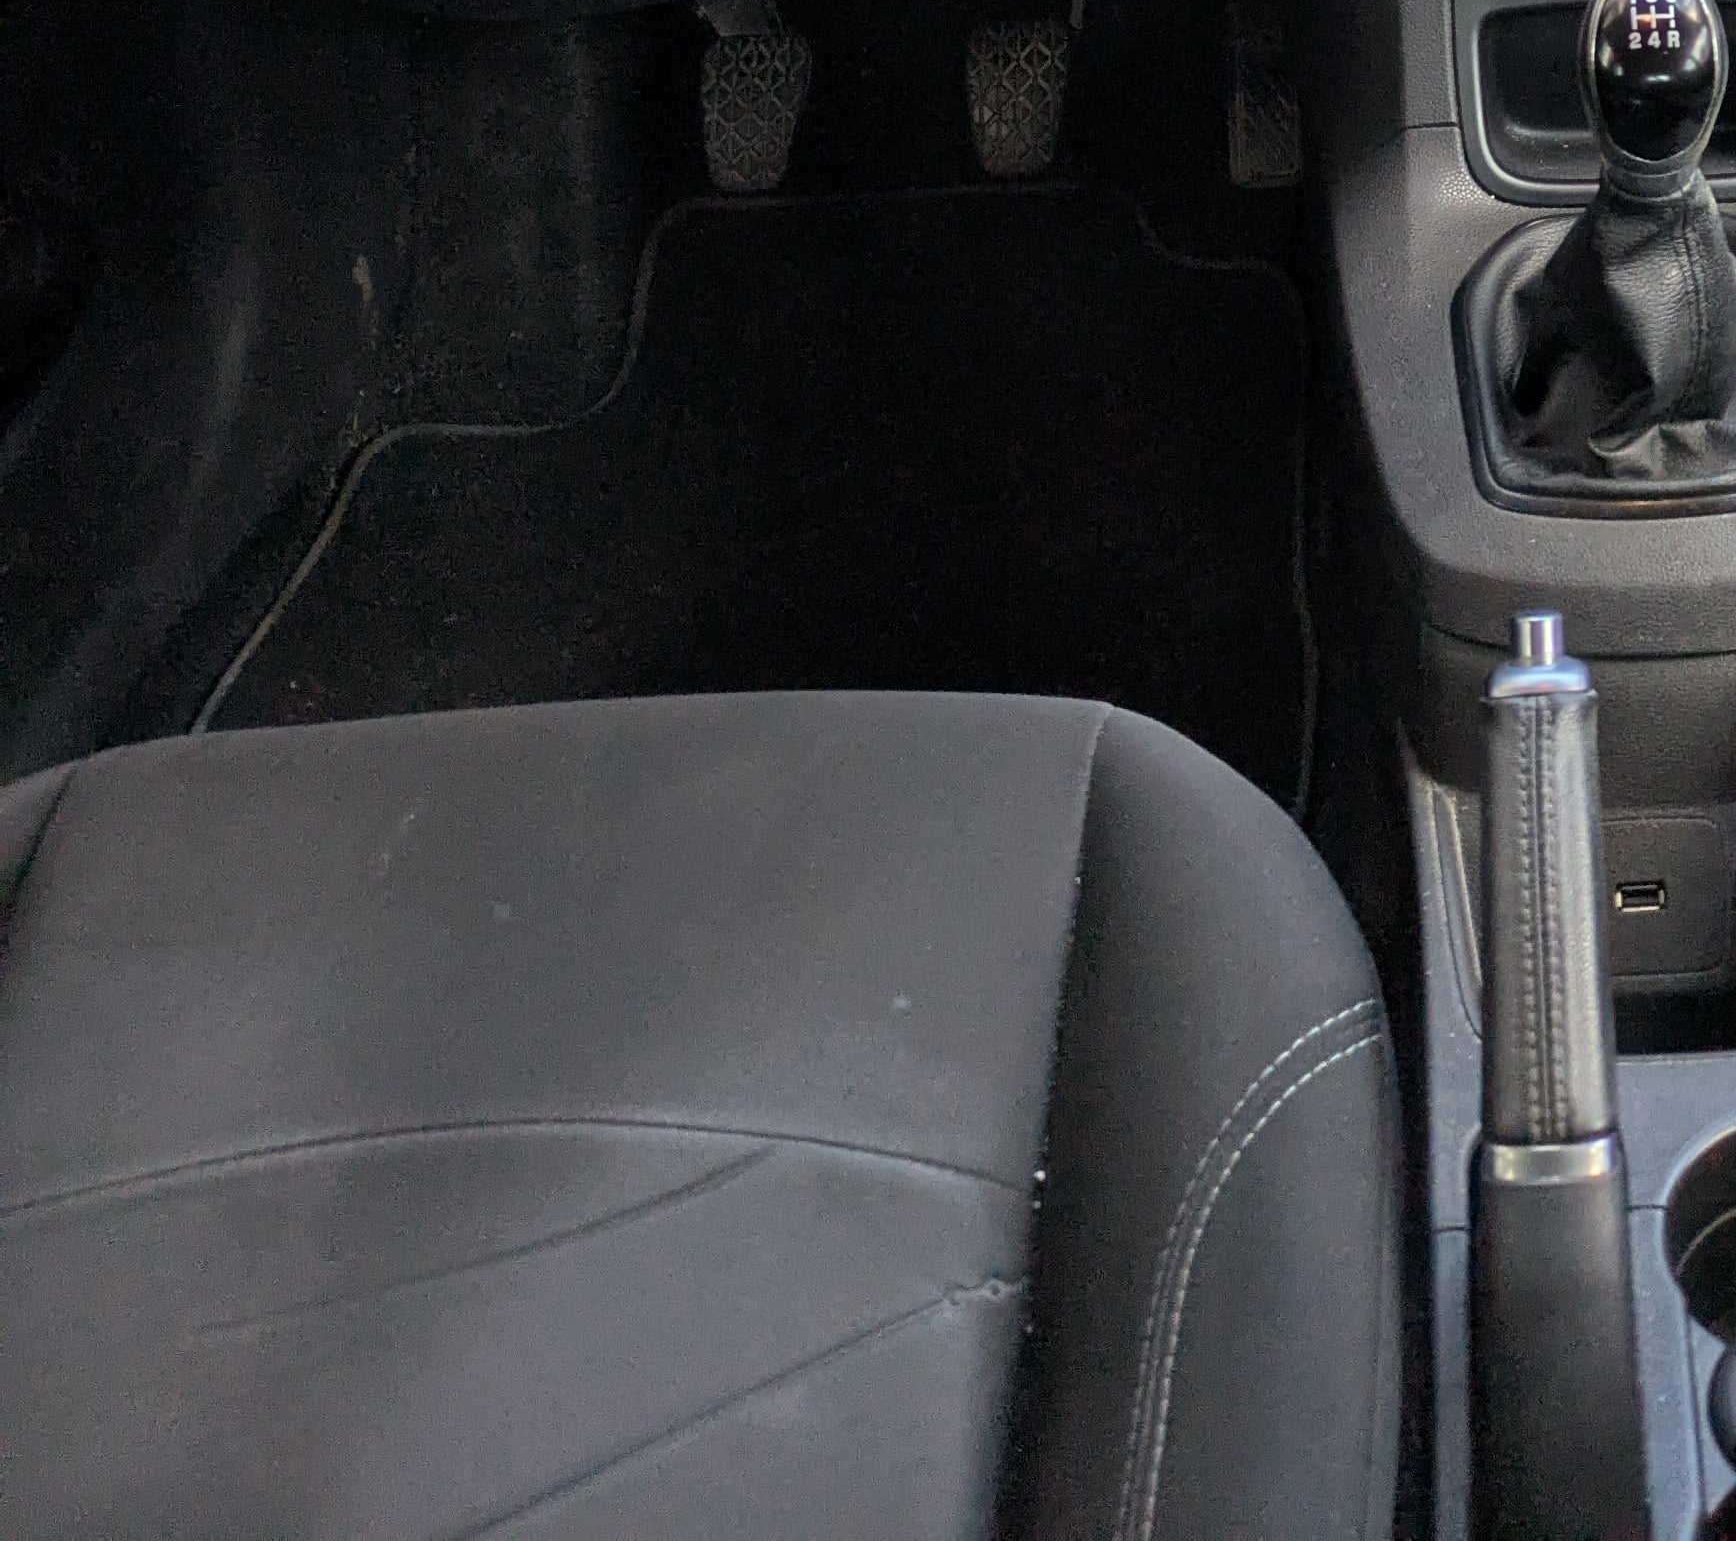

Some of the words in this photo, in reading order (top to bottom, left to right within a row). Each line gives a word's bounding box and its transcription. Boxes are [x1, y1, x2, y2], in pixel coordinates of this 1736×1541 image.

[1628, 31, 1642, 49] 2
[1647, 30, 1661, 49] 4
[1667, 29, 1680, 48] R
